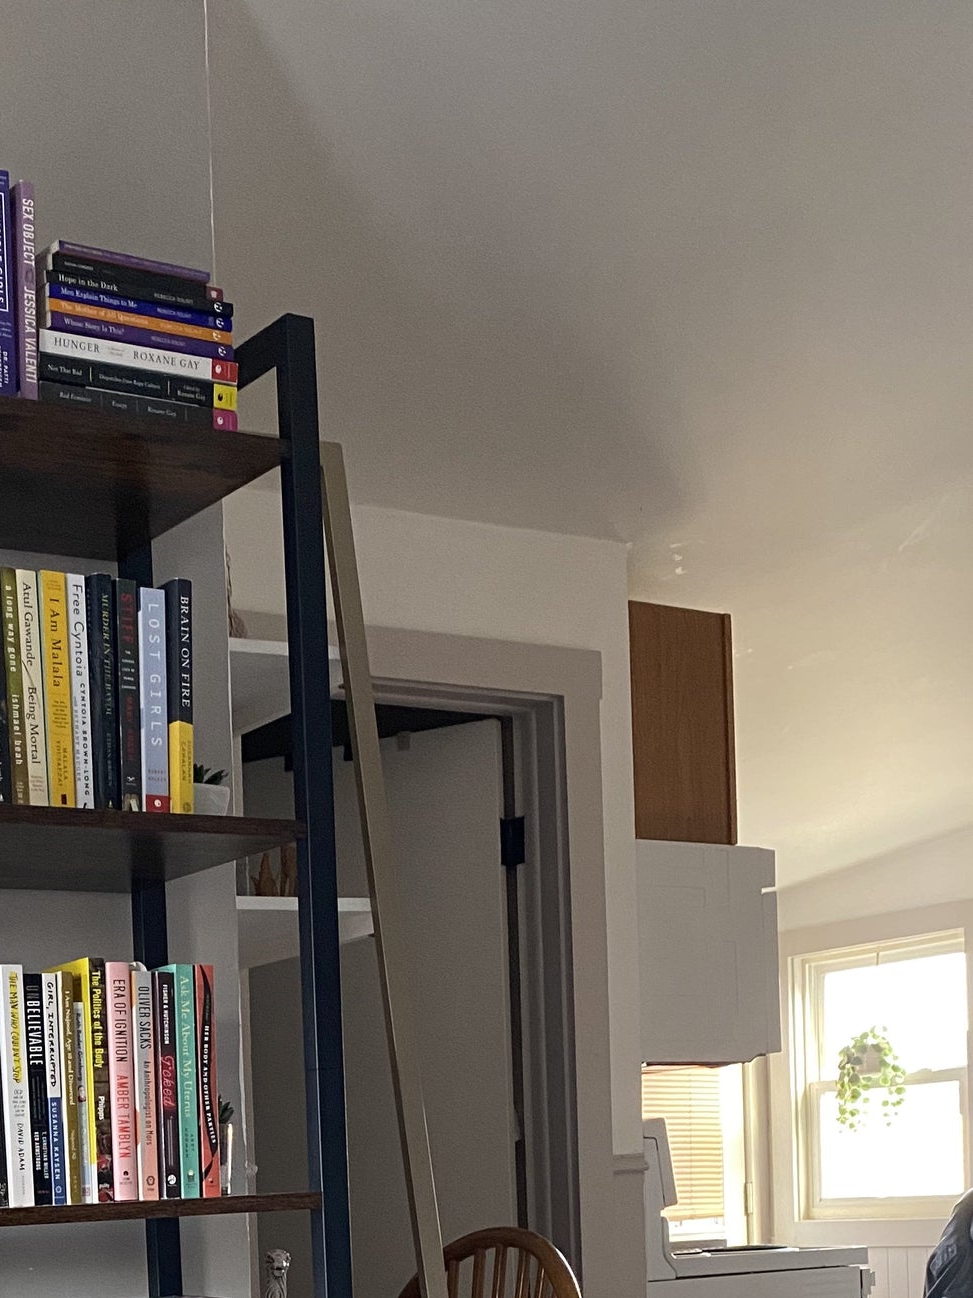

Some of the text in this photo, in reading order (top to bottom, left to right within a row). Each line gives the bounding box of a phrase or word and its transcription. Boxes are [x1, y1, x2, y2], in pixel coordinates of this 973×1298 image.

[22, 198, 37, 383] SEX OBJECT JESSICA VALENTI
[54, 337, 200, 370] HUNGER ROXANE GAY
[23, 583, 40, 764] Atul Gawande Being Mortal
[148, 604, 162, 746] LOST GIRLS
[180, 596, 190, 707] BRAIN ON FIRE
[26, 986, 43, 1065] UNBELIEVABLE
[46, 982, 56, 1009] GIRL,
[138, 986, 150, 1018] OLIVER
[48, 1013, 56, 1087] INTERRUPTED
[139, 1022, 151, 1049] SACKS
[144, 1061, 152, 1069] An
[113, 979, 131, 1158] ERA OF IGNITION AMBER TAMBLYN
[144, 1070, 153, 1118] Anthropologist
[146, 1130, 154, 1145] Mars
